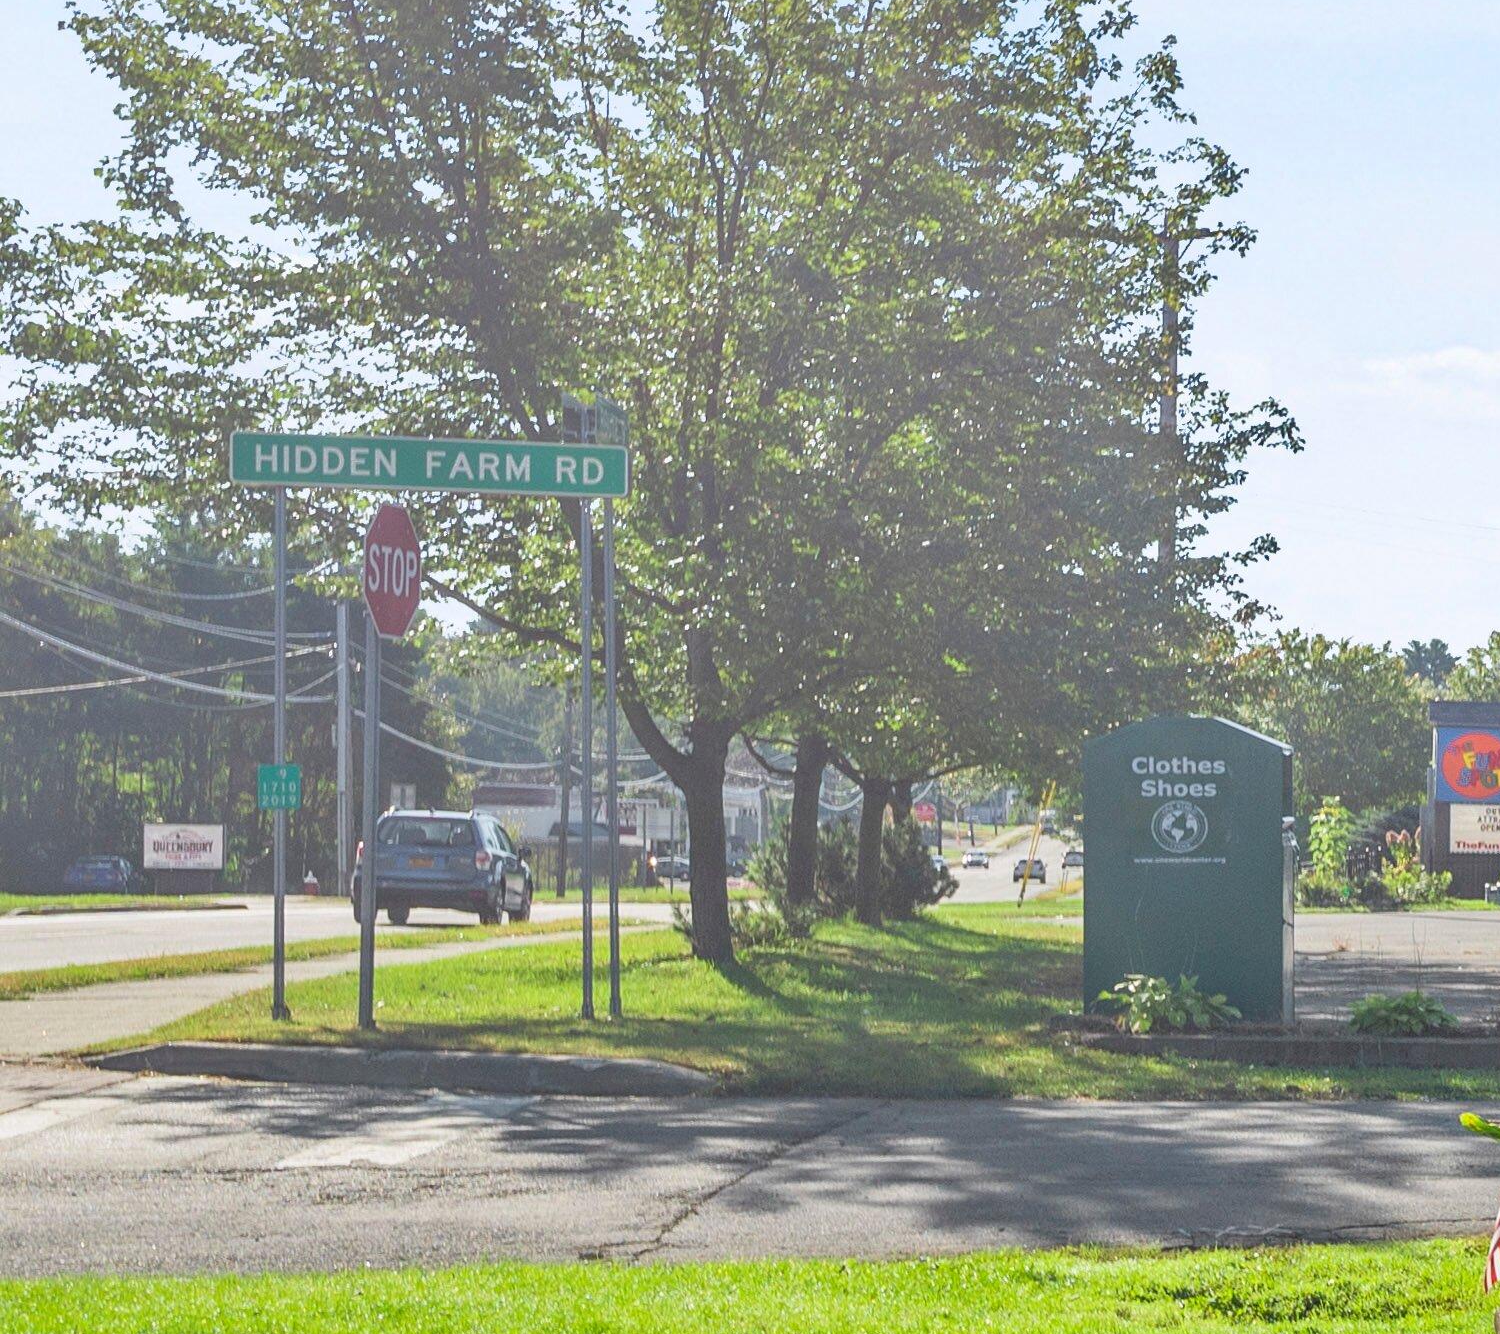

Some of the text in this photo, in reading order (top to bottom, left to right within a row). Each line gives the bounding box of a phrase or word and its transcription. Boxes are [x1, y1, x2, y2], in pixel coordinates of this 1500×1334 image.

[254, 444, 605, 485] HIDDEN FARM RD
[368, 543, 418, 598] STOP
[1131, 756, 1226, 774] Clothes
[263, 782, 296, 793] 1710
[1141, 779, 1217, 797] Shoes
[262, 795, 297, 806] 2019
[1480, 824, 1500, 832] OPEN
